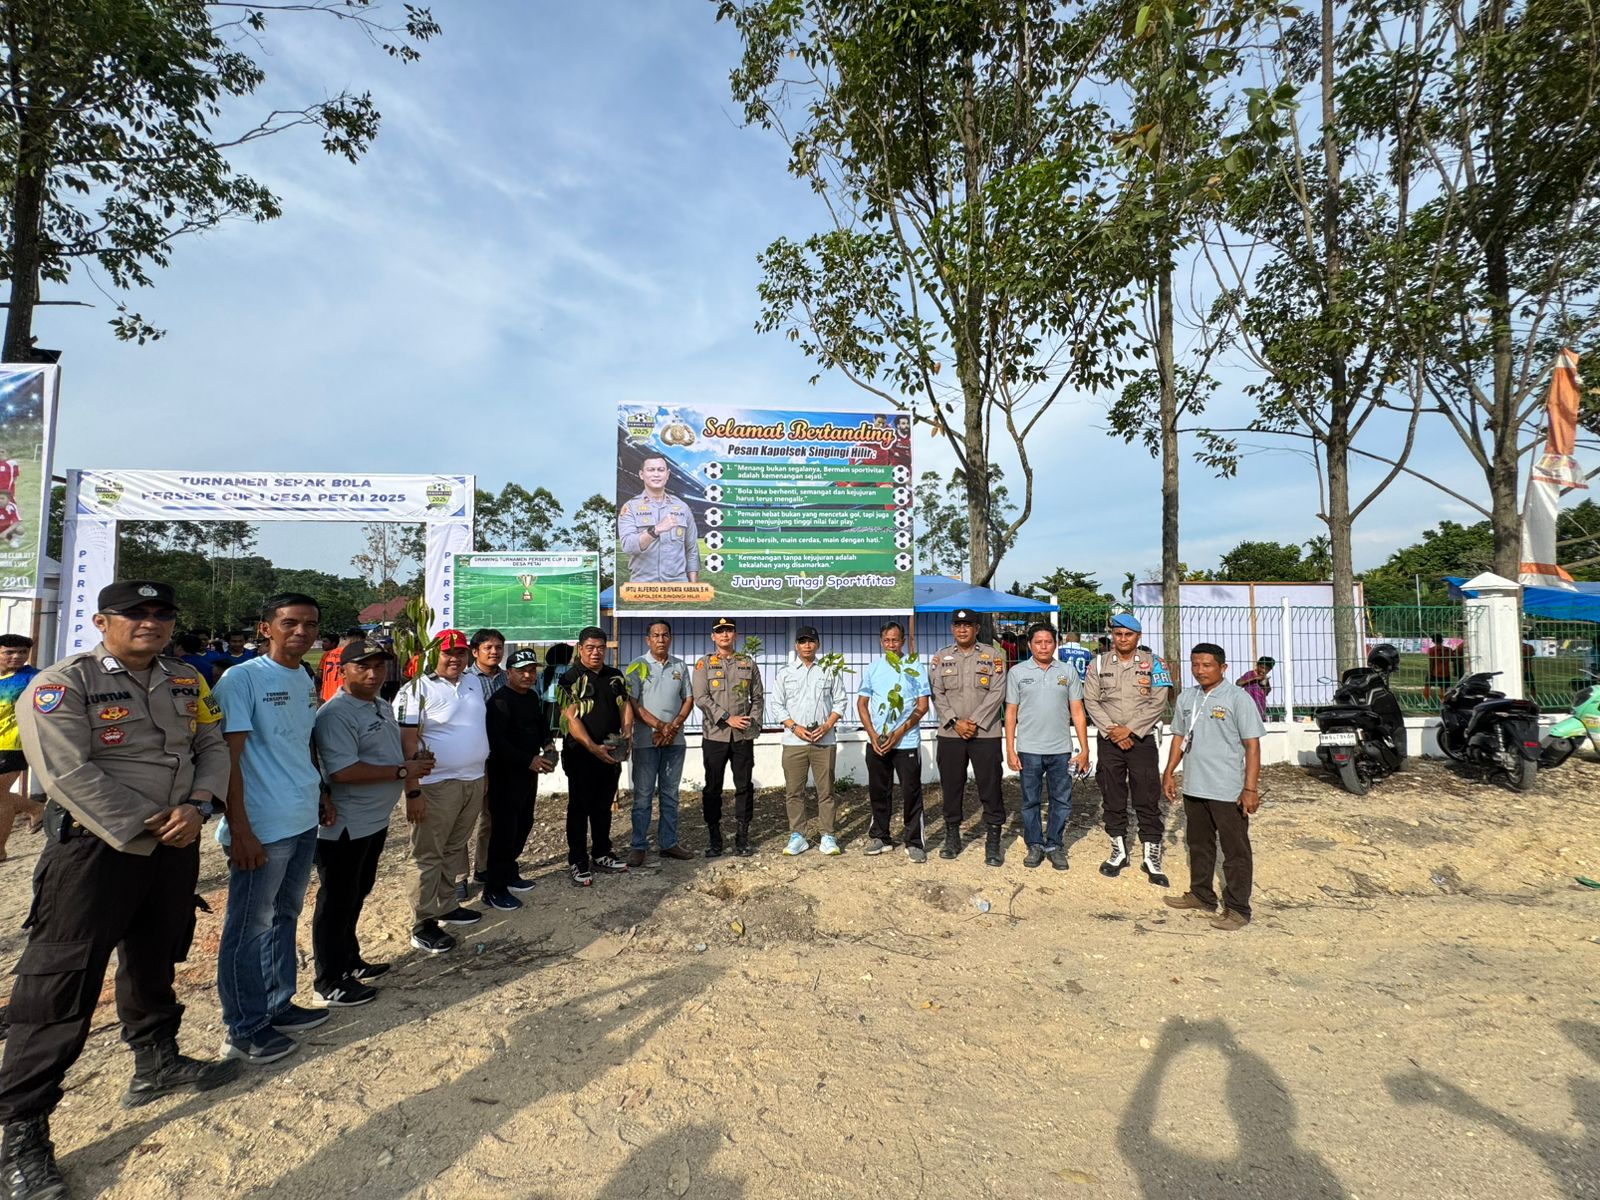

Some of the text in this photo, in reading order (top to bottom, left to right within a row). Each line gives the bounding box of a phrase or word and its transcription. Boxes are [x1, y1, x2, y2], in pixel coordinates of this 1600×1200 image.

[703, 417, 895, 447] Selamat Bertanding
[728, 445, 758, 456] Pesan
[761, 446, 807, 457] Kapolsek
[808, 447, 849, 459] Singingi
[179, 476, 372, 488] TURNAMEN SEPAK BOLA
[761, 472, 803, 480] kemenangan
[222, 492, 253, 501] CUP
[270, 493, 312, 502] DESA
[318, 494, 365, 502] PETAI
[370, 494, 407, 502] 2025
[800, 489, 832, 497] semangat
[803, 554, 834, 562] kejujuran
[732, 575, 895, 589] Junjung Tinggi Sportifitas
[74, 550, 87, 648] PERSEPE
